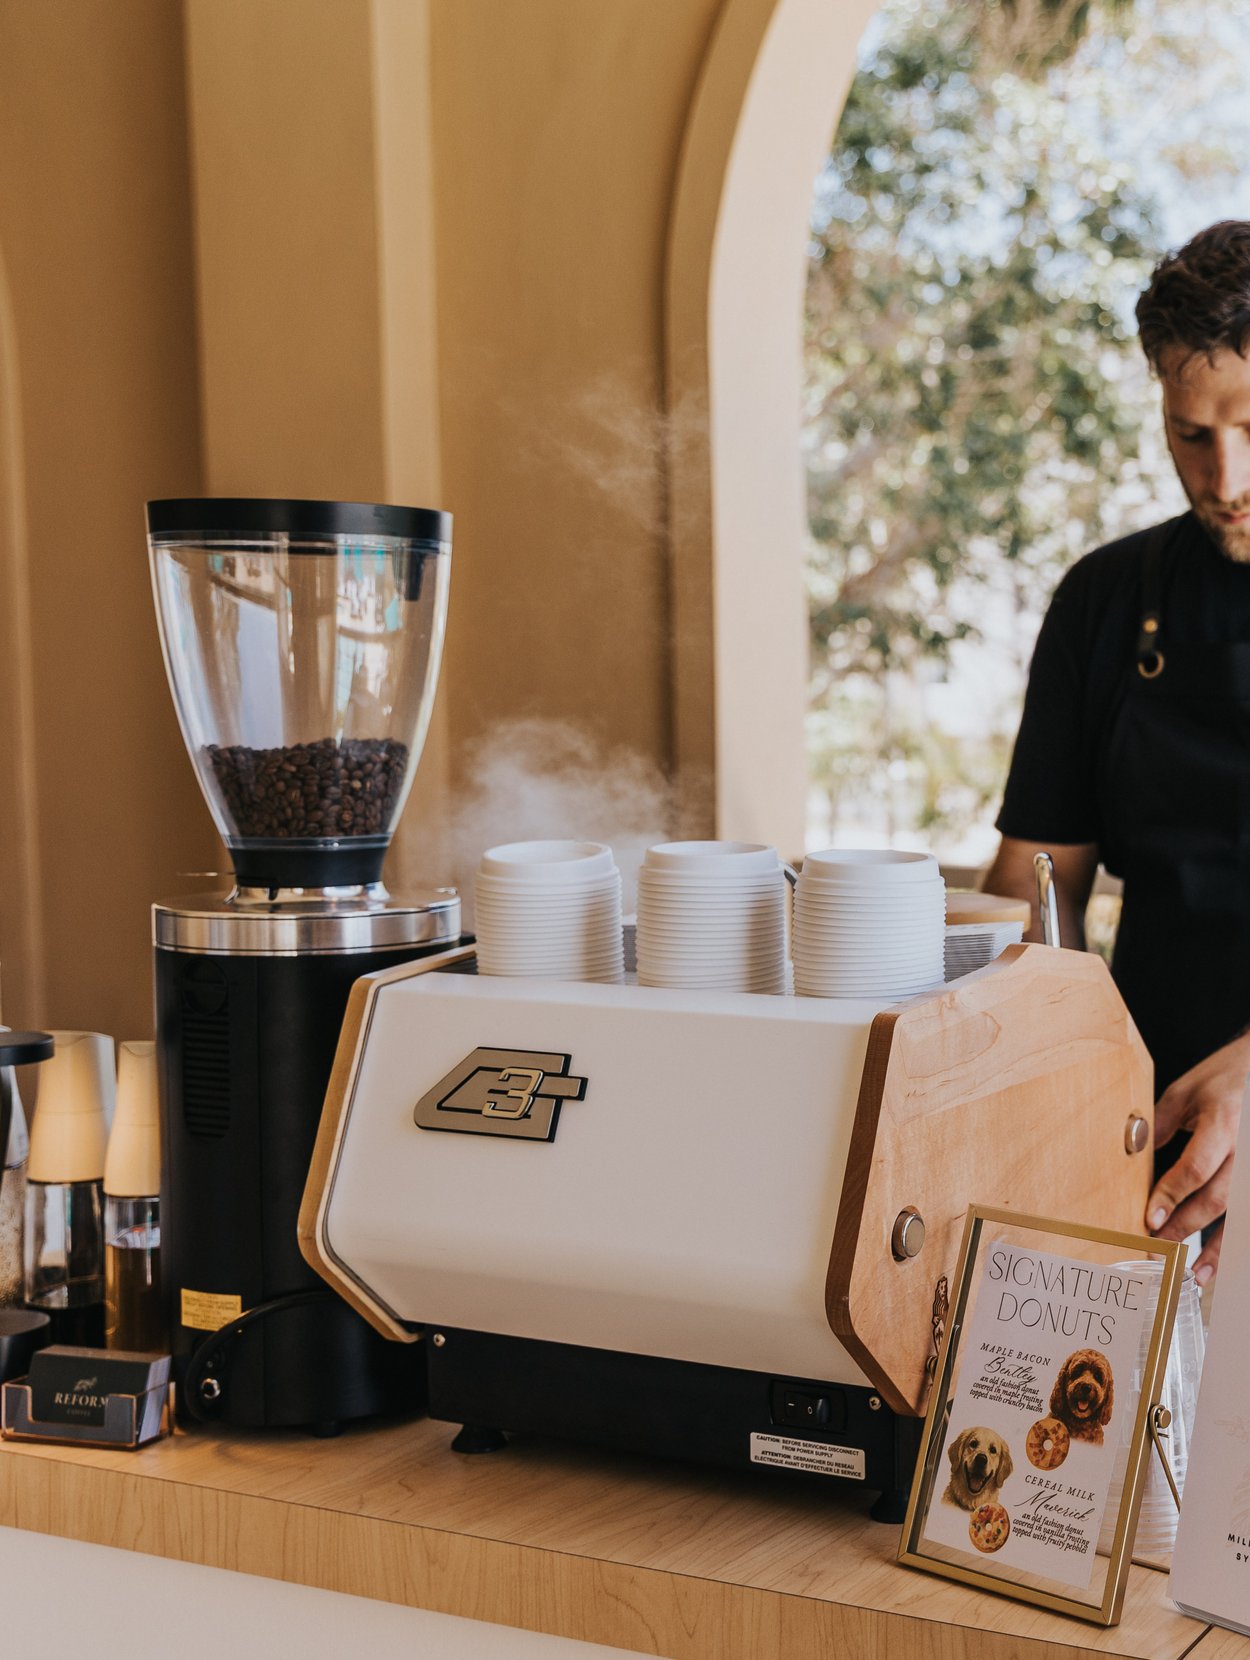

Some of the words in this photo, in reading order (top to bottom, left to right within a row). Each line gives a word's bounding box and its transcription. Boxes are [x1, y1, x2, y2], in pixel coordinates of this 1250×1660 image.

[989, 1251, 1143, 1311] SIGNATURE
[997, 1291, 1116, 1346] DONUTS
[980, 1342, 1015, 1358] MAPLE
[1016, 1351, 1051, 1367] BACON
[984, 1356, 1038, 1387] Bentley
[973, 1382, 994, 1392] covered
[994, 1385, 1001, 1394] in
[1002, 1389, 1020, 1400] maple
[1020, 1392, 1043, 1407] frosting
[989, 1376, 999, 1385] old
[1000, 1378, 1020, 1391] fashion
[1021, 1384, 1040, 1395] donut
[970, 1389, 989, 1399] topped
[989, 1393, 1002, 1402] with
[1002, 1397, 1025, 1411] crunchy
[1025, 1401, 1043, 1413] bacon
[802, 1442, 828, 1451] SERVICING
[828, 1446, 860, 1456] DISCONNECT
[815, 1450, 833, 1458] SUPPLY
[784, 1459, 800, 1467] AVANT
[841, 1469, 862, 1478] SERVICE
[1025, 1474, 1062, 1493] CEREAL
[1066, 1486, 1095, 1501] MILK
[1013, 1489, 1096, 1522] Maverick
[1013, 1518, 1034, 1529] covered
[1035, 1523, 1042, 1532] in
[1043, 1527, 1065, 1539] vanilla
[1065, 1533, 1090, 1548] frosting
[1022, 1512, 1030, 1520] an
[1031, 1513, 1042, 1523] old
[1040, 1516, 1064, 1529] fashion
[1065, 1523, 1084, 1535] donut
[1012, 1526, 1032, 1537] topped
[1032, 1531, 1046, 1541] with
[1045, 1535, 1065, 1549] fruity
[1064, 1541, 1088, 1554] pebbles
